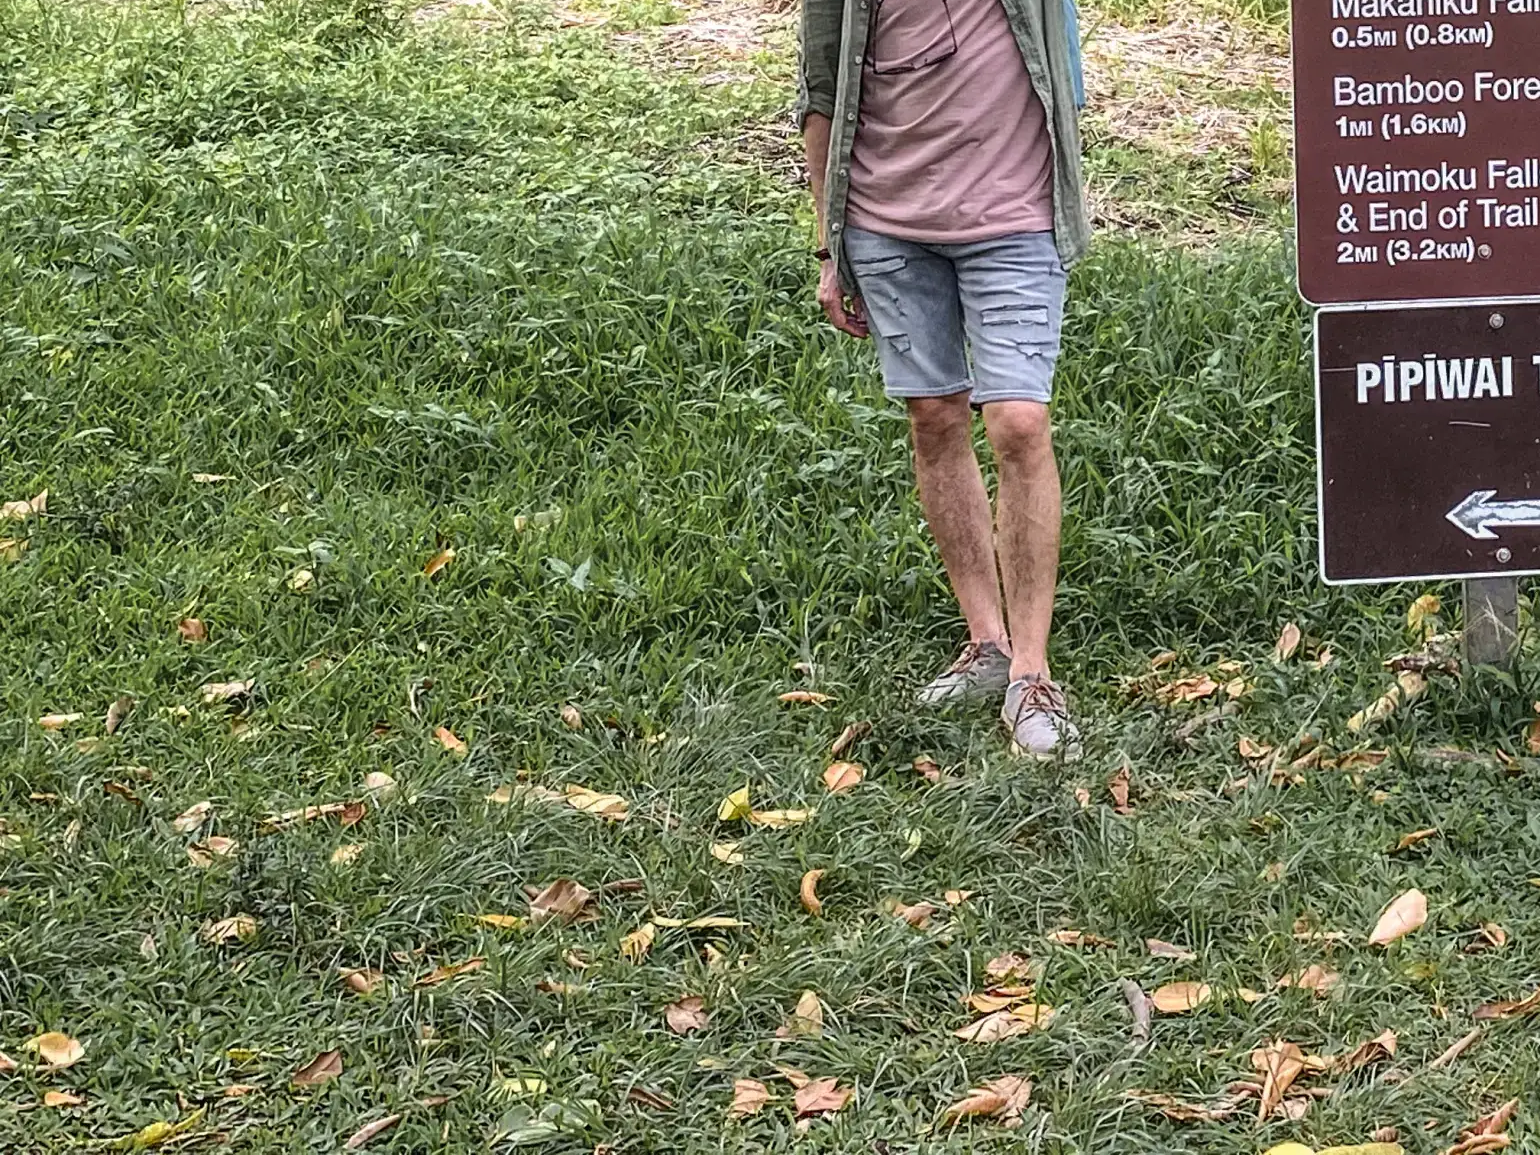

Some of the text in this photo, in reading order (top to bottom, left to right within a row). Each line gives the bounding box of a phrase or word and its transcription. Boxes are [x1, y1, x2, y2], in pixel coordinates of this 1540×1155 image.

[1334, 75, 1463, 106] Bamboo
[1334, 162, 1476, 194] Waimoku
[1336, 198, 1539, 233] & End of Trail
